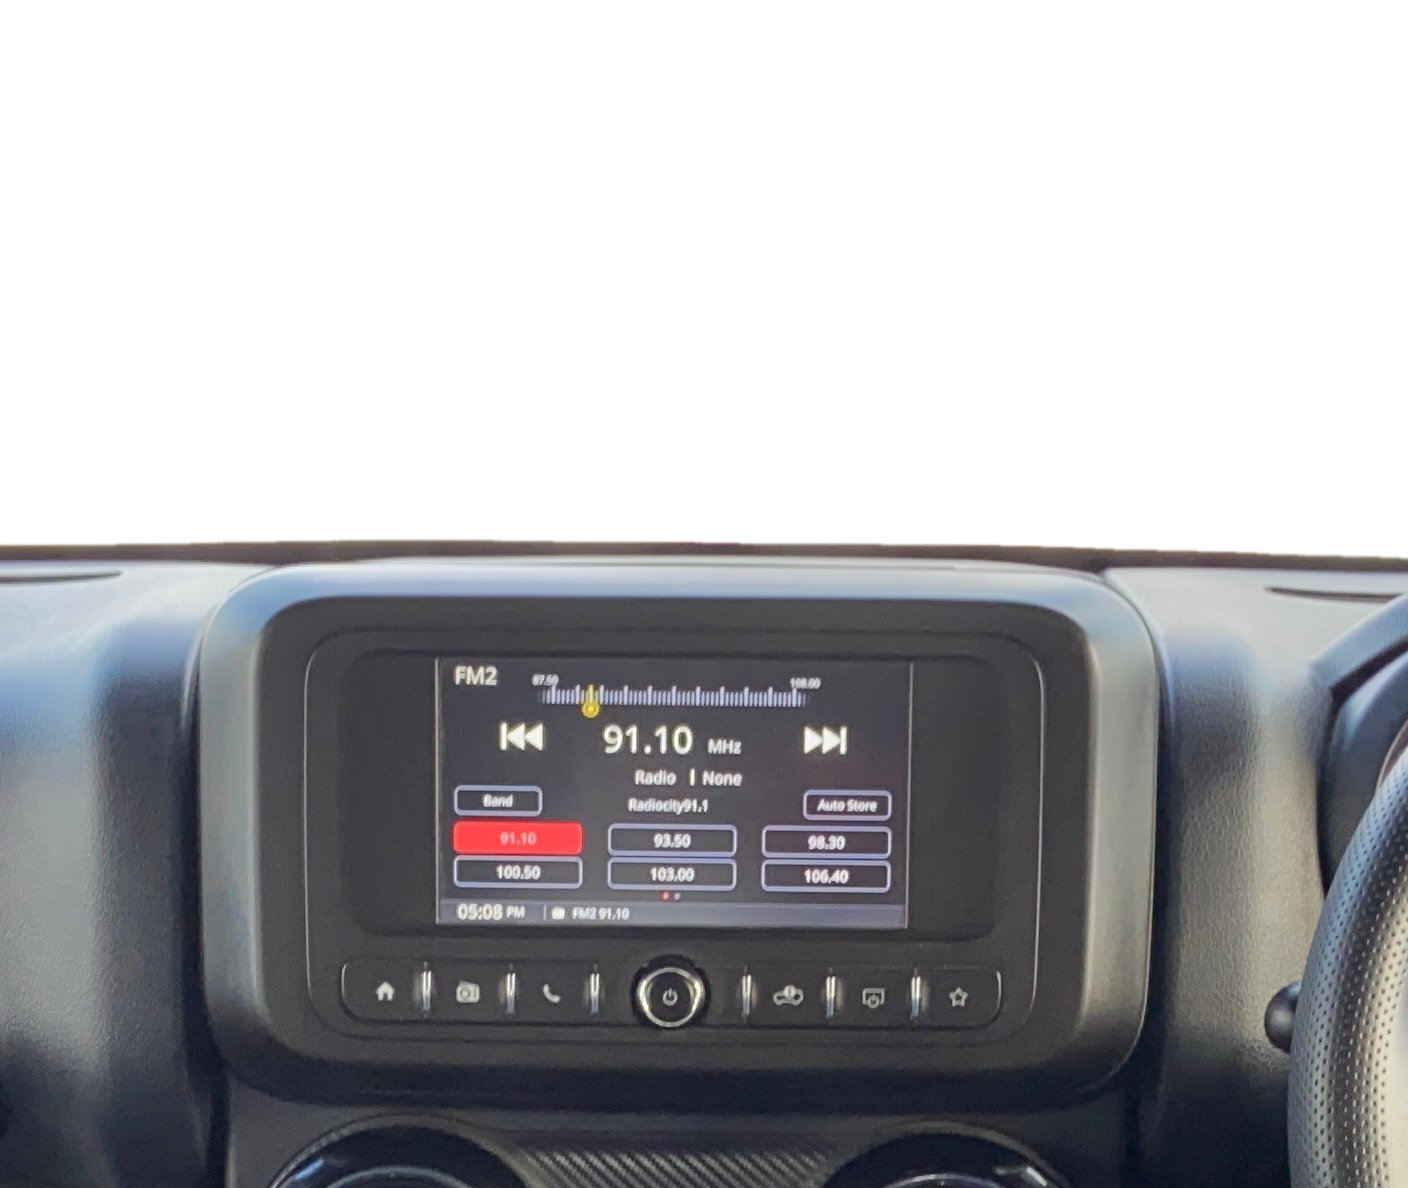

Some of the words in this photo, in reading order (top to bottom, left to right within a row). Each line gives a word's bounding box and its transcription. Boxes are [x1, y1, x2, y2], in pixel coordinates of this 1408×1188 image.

[454, 666, 498, 686] FM2
[603, 725, 693, 754] 91.10
[708, 739, 742, 755] MHz
[634, 770, 676, 786] Radio
[702, 771, 742, 787] None
[482, 794, 514, 808] Band
[627, 798, 709, 815] Radiocity91.1
[817, 799, 844, 812] Auto
[846, 799, 878, 812] Store
[499, 832, 537, 846] 91.10
[653, 833, 691, 848] 93.50
[496, 865, 541, 880] 100.50
[650, 867, 695, 882] 103.00
[804, 869, 849, 884] 106.40
[456, 904, 503, 920] 05:08
[506, 905, 525, 918] PM
[572, 907, 596, 920] FM2
[598, 907, 630, 920] 91.10
